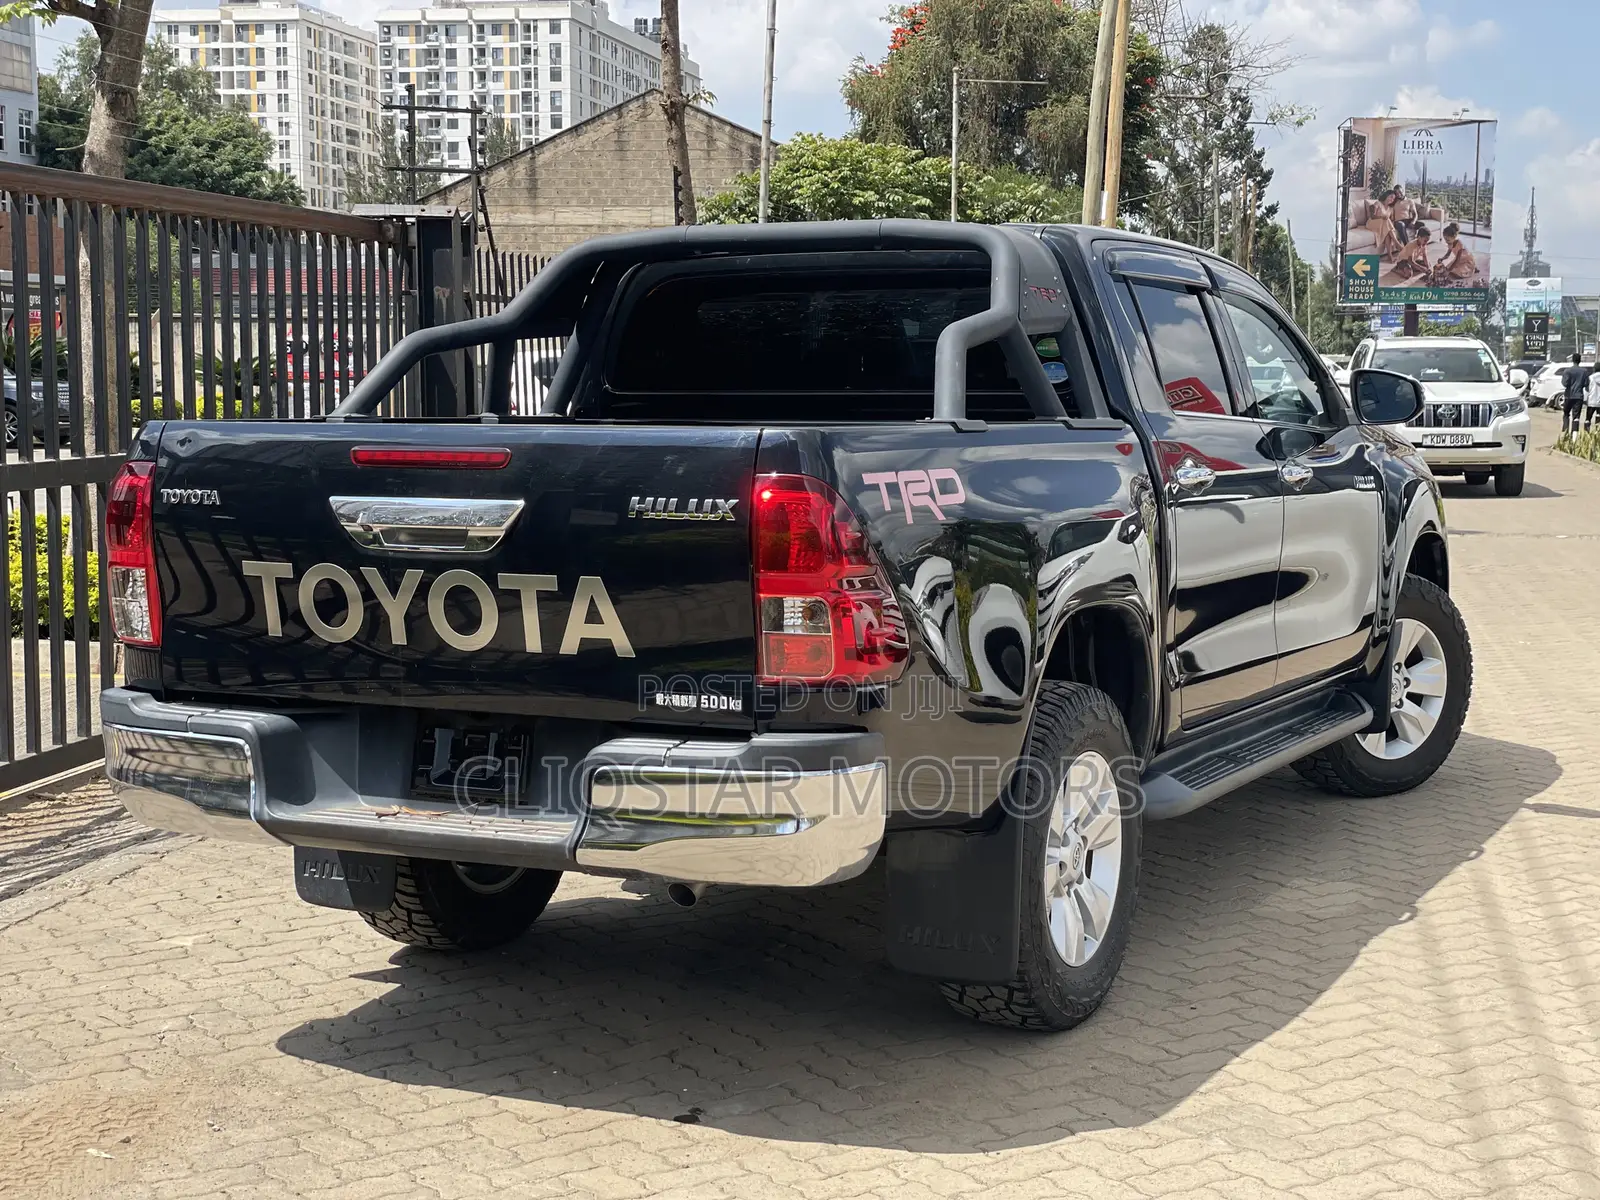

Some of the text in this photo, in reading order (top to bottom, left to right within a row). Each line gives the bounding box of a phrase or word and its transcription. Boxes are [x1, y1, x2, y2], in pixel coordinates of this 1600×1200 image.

[1403, 140, 1443, 150] LIBRA
[1431, 435, 1447, 445] KDW
[160, 488, 220, 505] TOYOTA
[628, 496, 740, 521] HILUX
[861, 468, 966, 525] TRD
[242, 560, 635, 658] TOYOTA
[303, 860, 383, 884] HILUX
